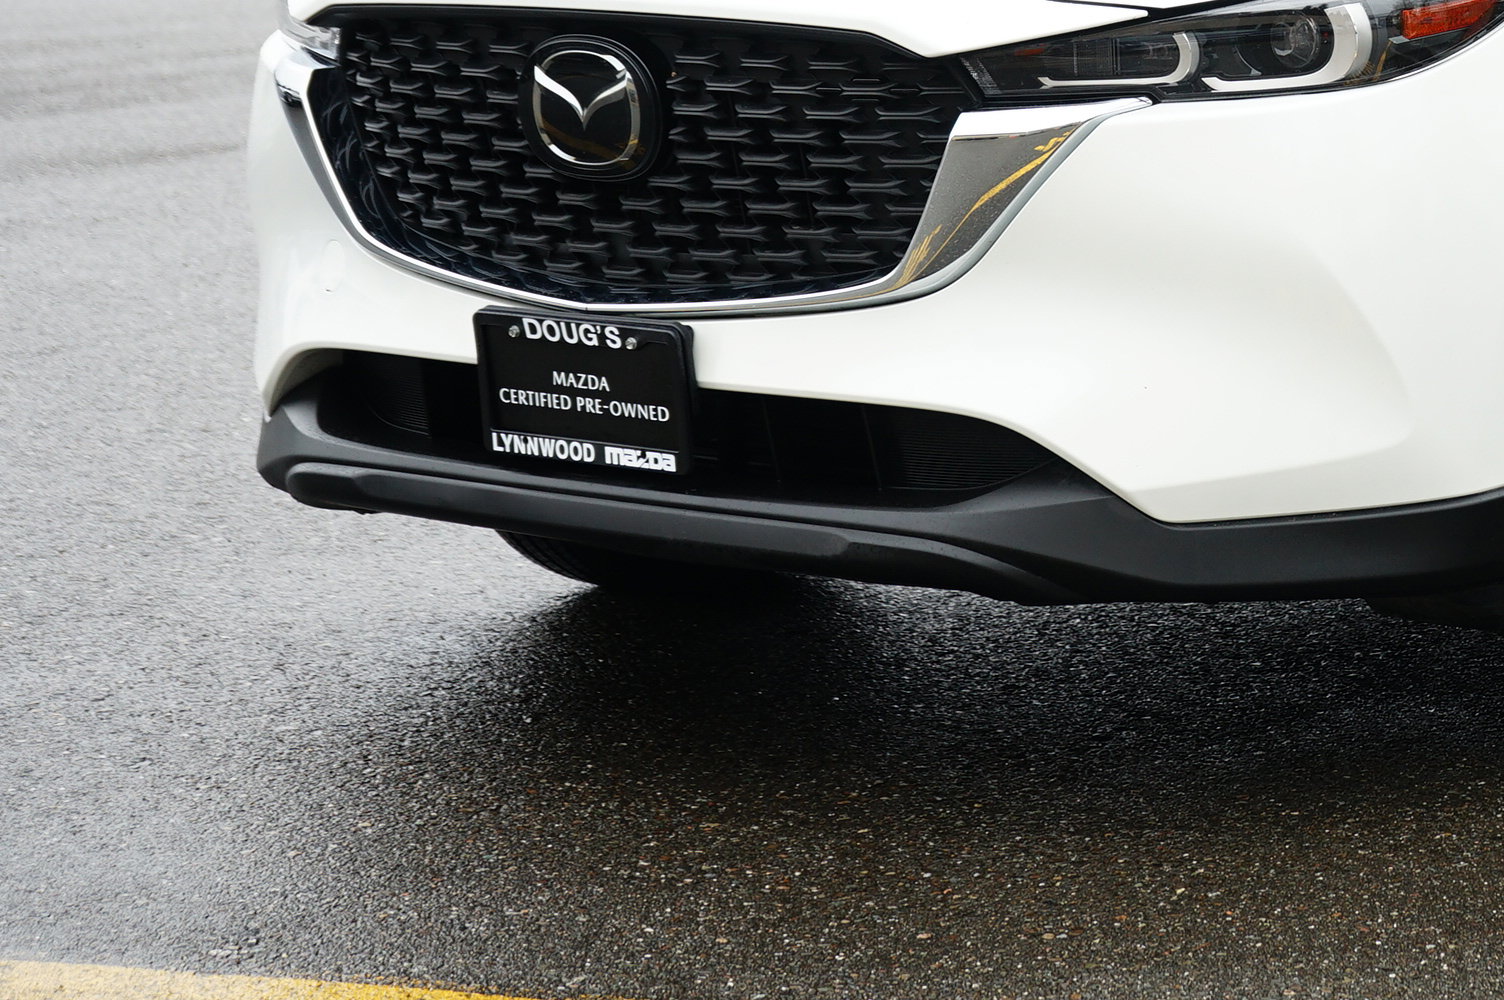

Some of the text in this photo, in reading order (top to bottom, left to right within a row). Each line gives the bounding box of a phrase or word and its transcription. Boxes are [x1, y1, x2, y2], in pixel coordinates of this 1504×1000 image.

[522, 317, 622, 349] DOUG'S
[552, 370, 610, 392] MAZDA
[499, 387, 670, 422] CERTIFIED PRE-OWNED
[491, 432, 595, 463] LYNNWOOD
